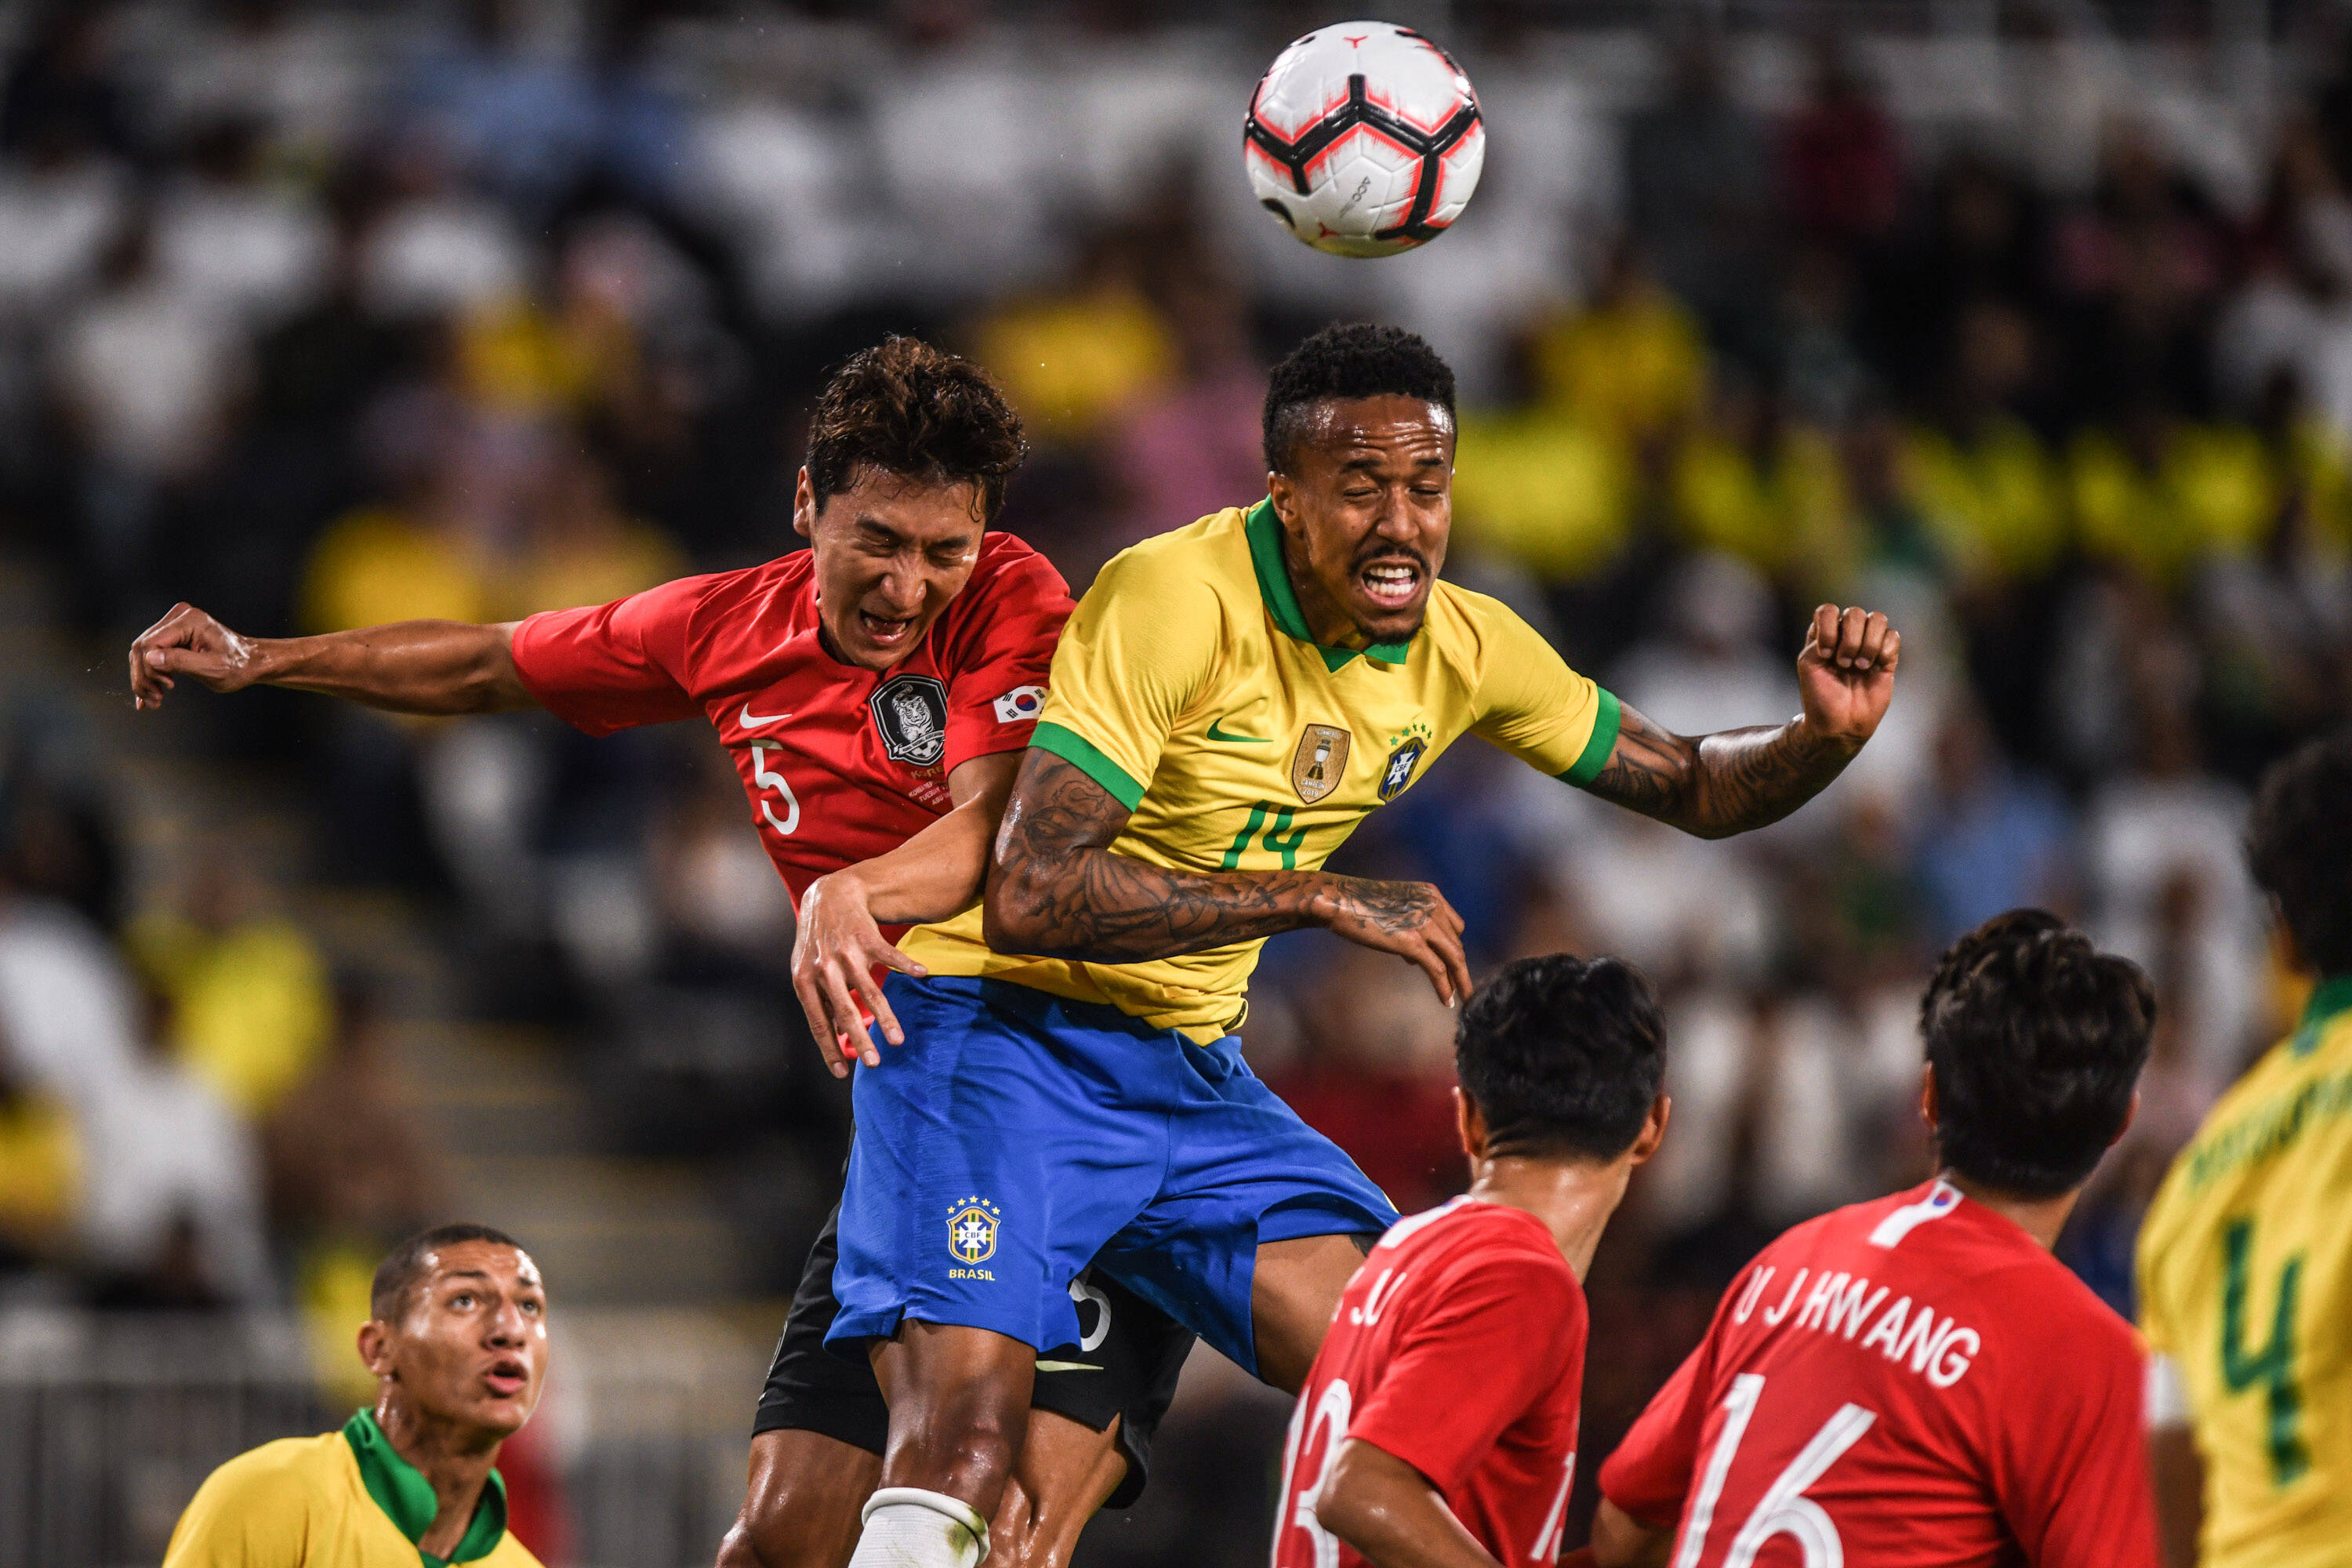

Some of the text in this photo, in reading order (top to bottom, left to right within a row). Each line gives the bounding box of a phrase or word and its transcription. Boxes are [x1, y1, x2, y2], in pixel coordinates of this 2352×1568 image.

[750, 739, 800, 836] 5
[1302, 789, 1319, 797] 2019
[1395, 763, 1408, 773] CBF
[1219, 798, 1314, 872] 14
[949, 1269, 996, 1281] BRASIL
[1734, 1265, 1981, 1389] U J HWANG
[2222, 1215, 2310, 1486] 4
[1677, 1372, 1878, 1567] 16
